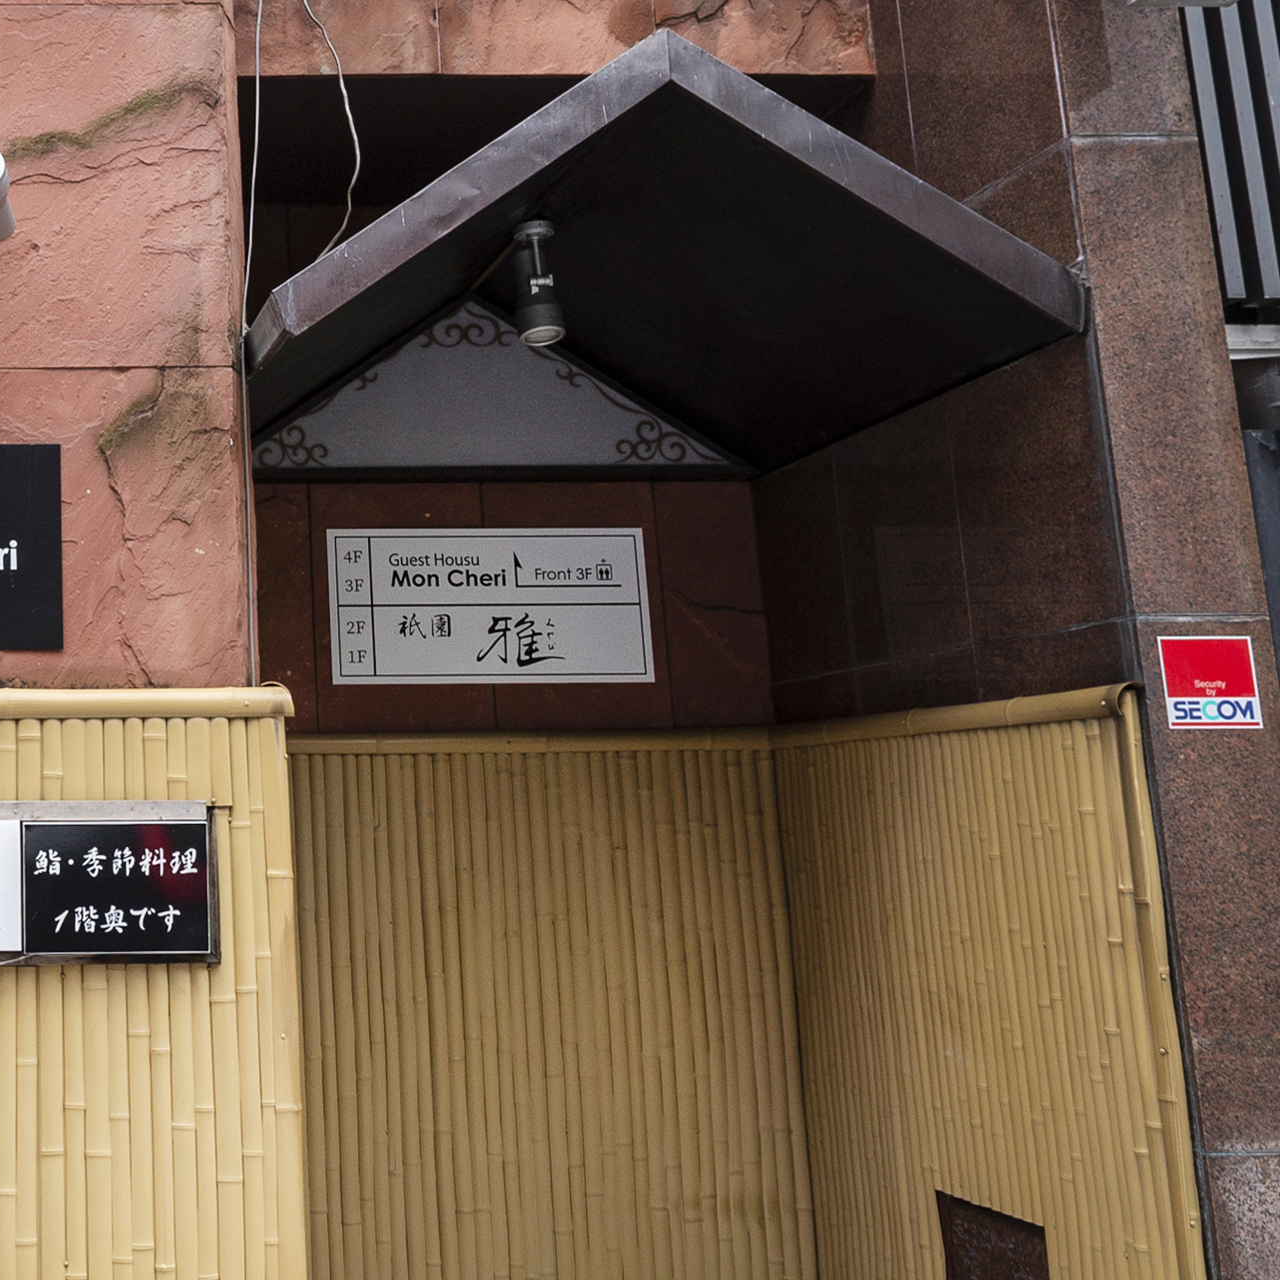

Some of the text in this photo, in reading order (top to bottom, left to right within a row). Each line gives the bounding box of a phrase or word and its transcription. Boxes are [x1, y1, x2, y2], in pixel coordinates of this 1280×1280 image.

[343, 550, 363, 564] 4F
[388, 552, 480, 567] Guest Housu
[390, 568, 507, 588] Mon Cheri
[534, 567, 593, 581] Front 3F
[344, 578, 364, 593] 3F
[346, 620, 366, 635] 2F
[398, 612, 566, 668] 祇園 雅
[348, 649, 368, 665] 1F
[1193, 679, 1226, 689] Security
[1205, 688, 1217, 697] by
[1173, 699, 1255, 720] SECOM
[33, 846, 199, 878] 鮨・季節料理
[54, 904, 182, 934] 1階奥です
